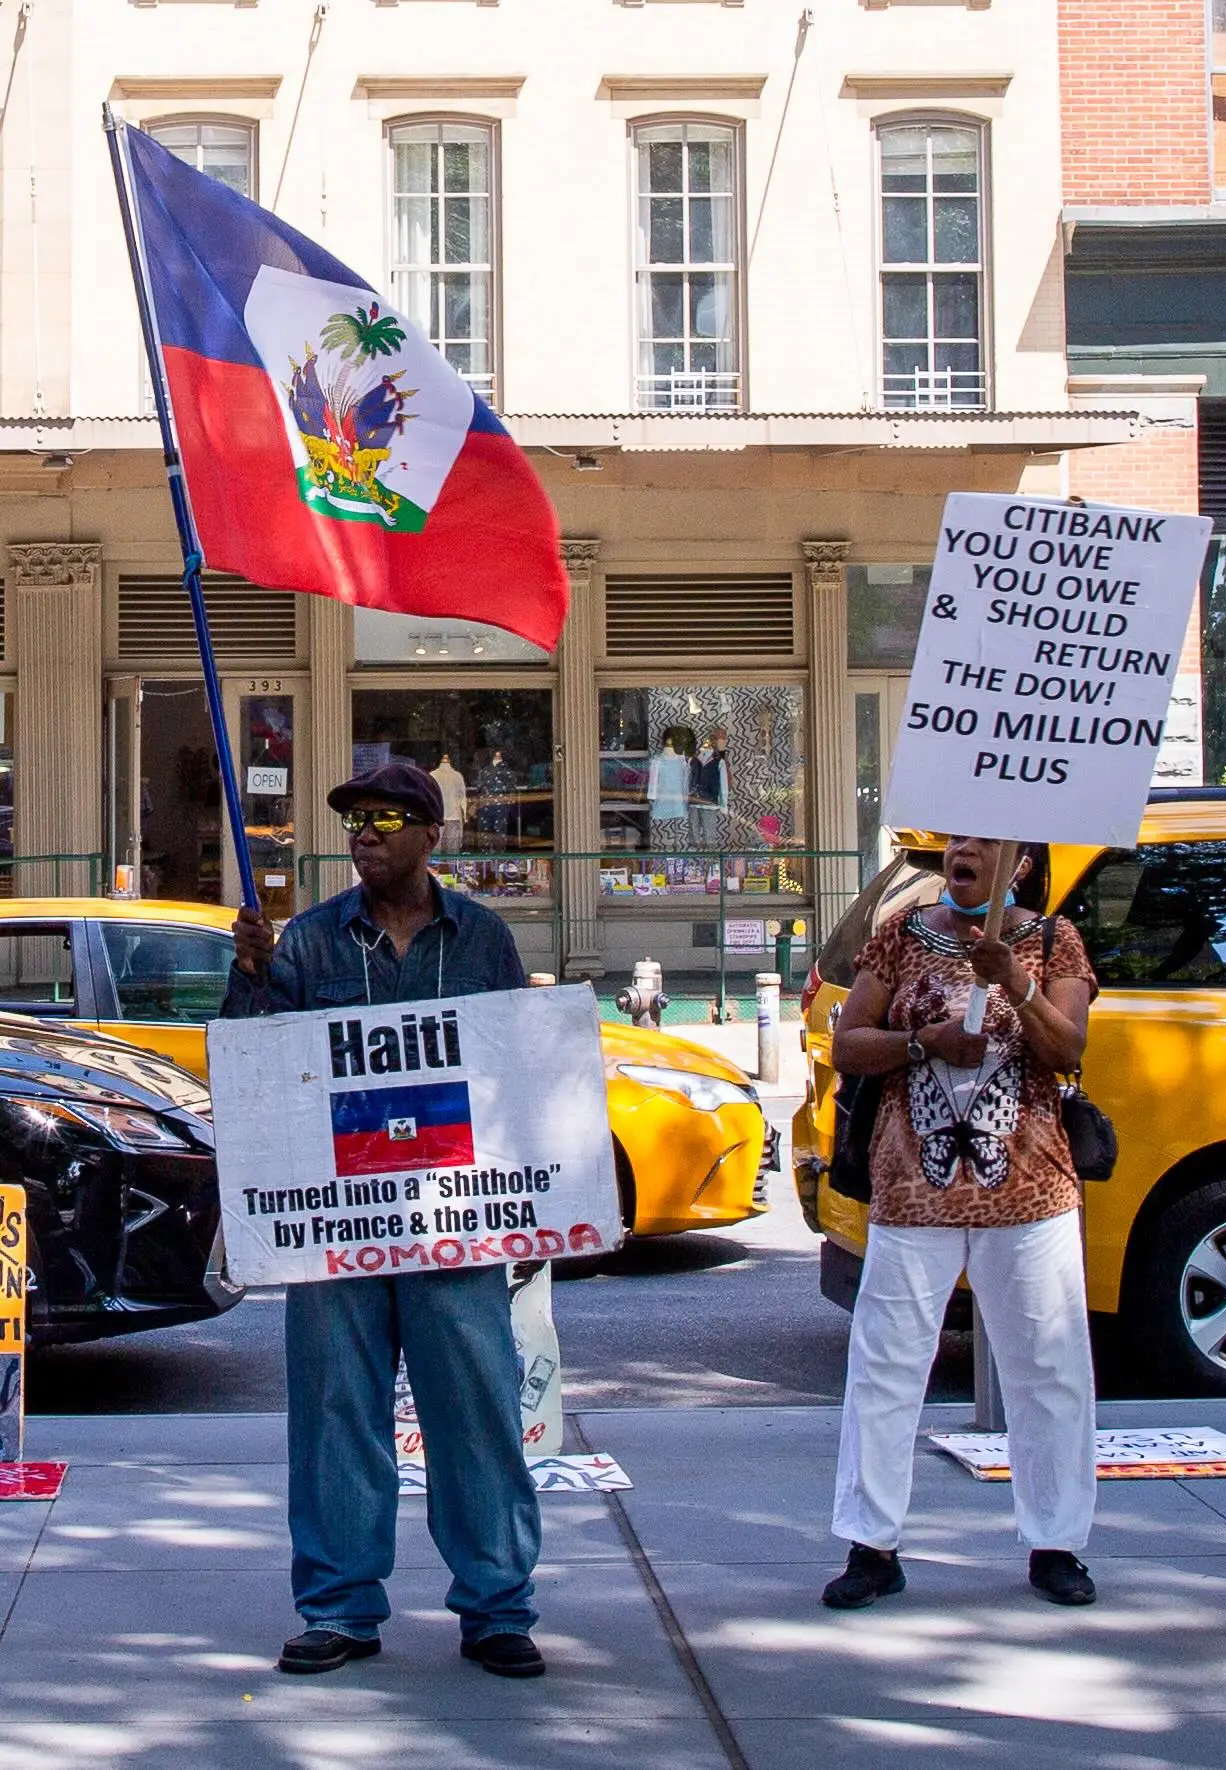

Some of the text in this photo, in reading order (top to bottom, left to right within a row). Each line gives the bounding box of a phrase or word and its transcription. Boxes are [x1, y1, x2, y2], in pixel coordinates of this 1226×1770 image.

[1004, 505, 1167, 544] CITIBANK
[944, 528, 1113, 571] YOU OWE
[973, 564, 1140, 606] YOU OWE
[932, 594, 1128, 638] & SHOULD
[1034, 641, 1171, 677] RETURN
[249, 680, 282, 692] 393
[942, 660, 1116, 706] THE DOW!
[906, 703, 1166, 747] 500 MILLION
[252, 773, 283, 789] OPEN
[973, 751, 1069, 785] PLUS
[327, 1009, 463, 1080] Haiti
[243, 1186, 340, 1216] Turned
[344, 1179, 397, 1207] into
[403, 1183, 421, 1203] a
[274, 1201, 537, 1249] by France & the USA
[326, 1223, 603, 1276] KOMOKODA
